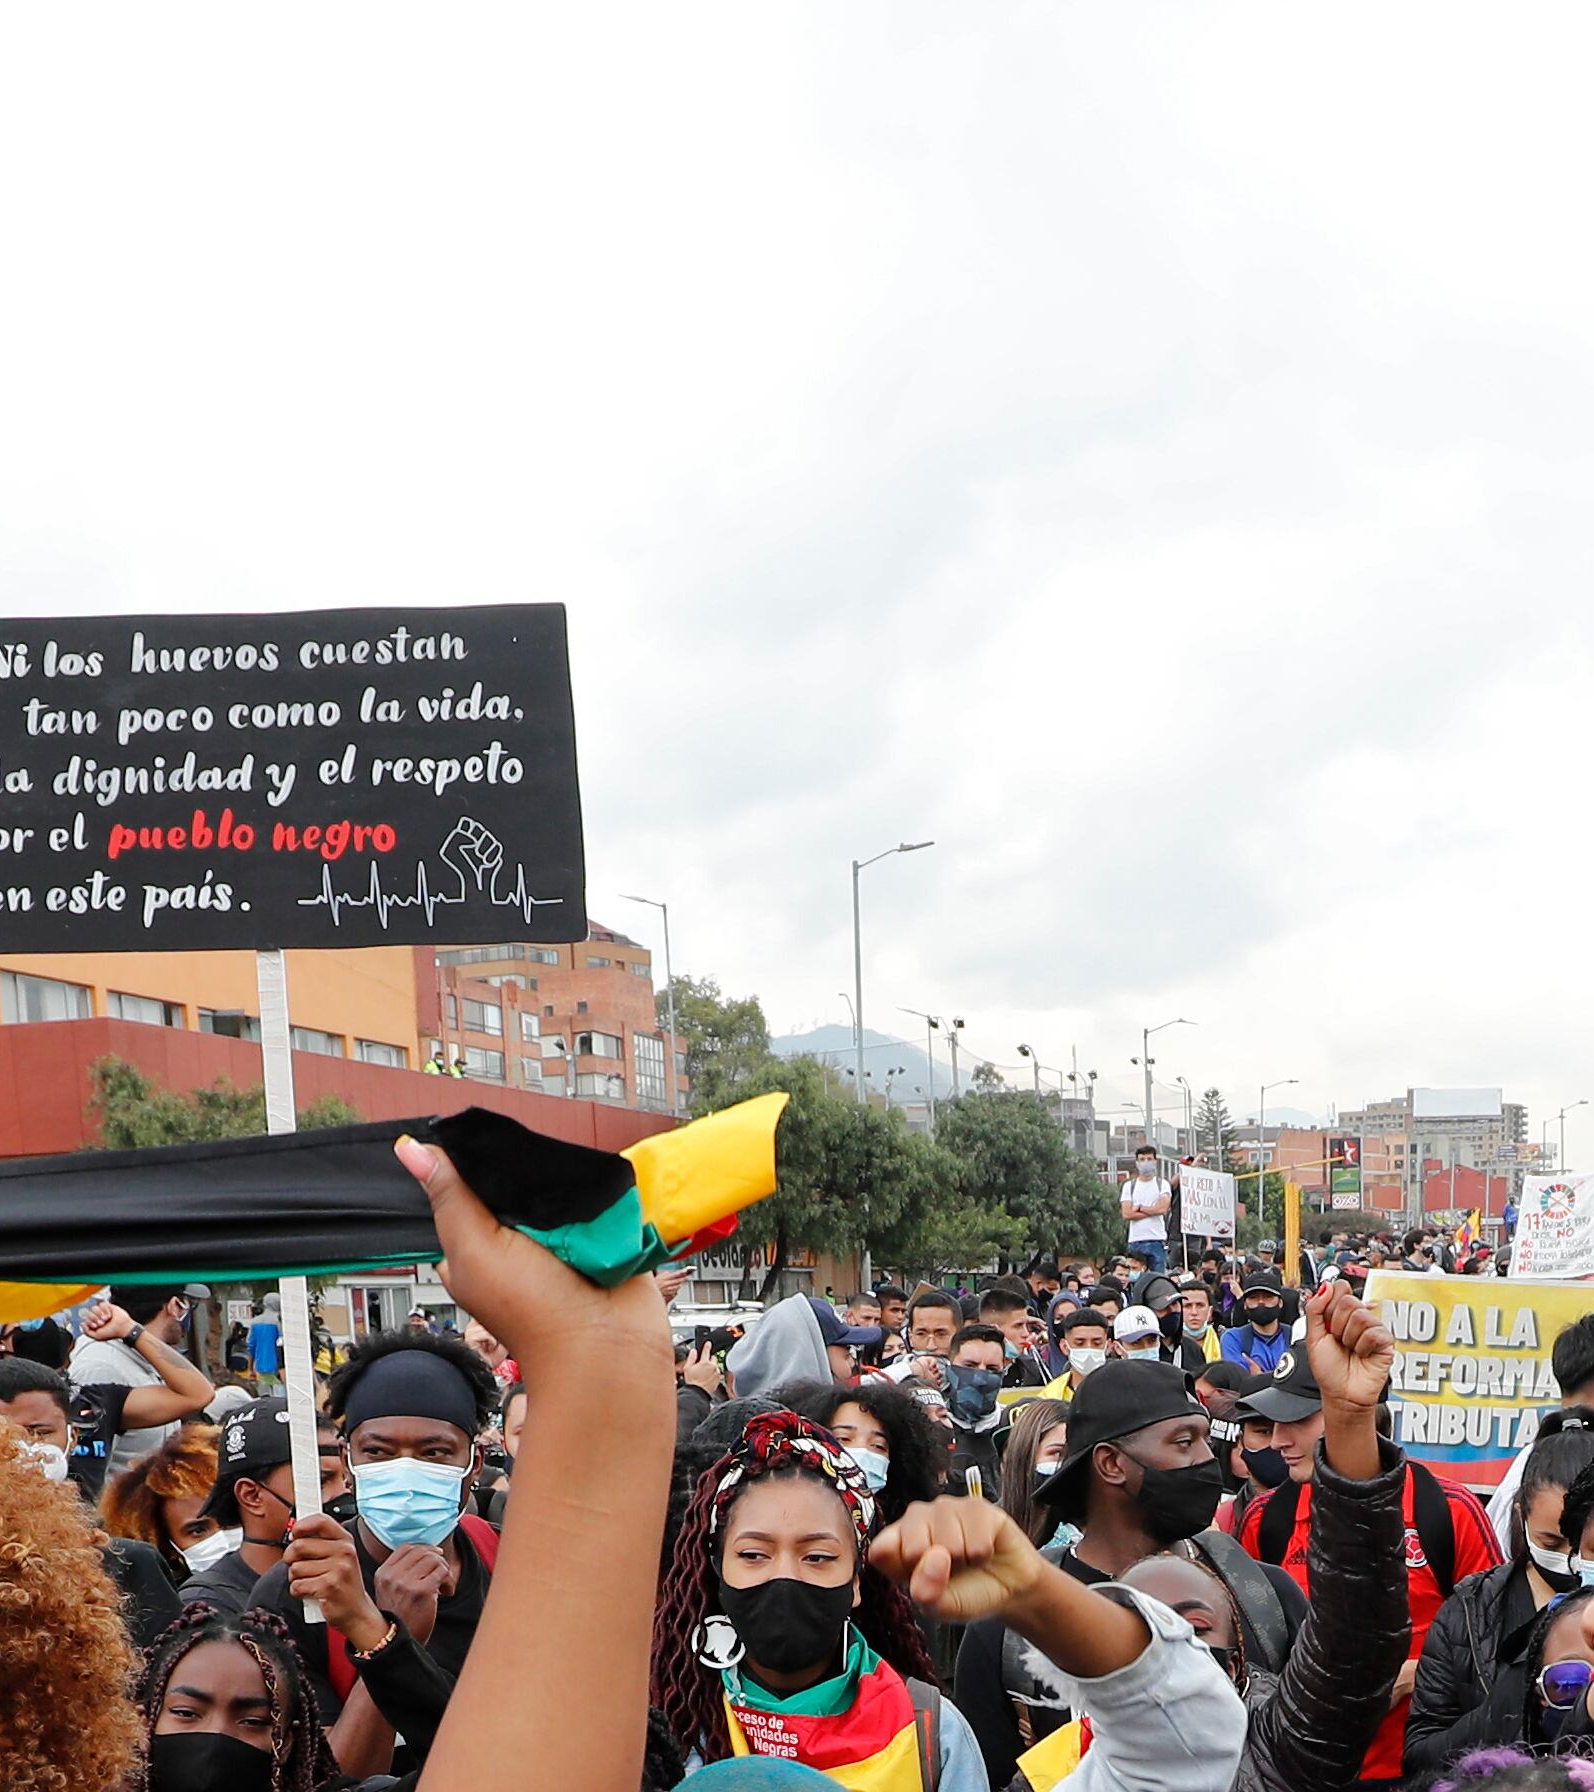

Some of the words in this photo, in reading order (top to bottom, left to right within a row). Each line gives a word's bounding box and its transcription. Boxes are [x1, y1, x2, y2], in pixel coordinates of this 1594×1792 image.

[43, 639, 104, 677] los
[132, 632, 280, 674] huevos
[299, 626, 468, 669] cuestan
[24, 697, 100, 735] tan
[118, 706, 214, 746] poco
[228, 700, 341, 729] como
[359, 686, 405, 725] la
[52, 751, 254, 806] dignidad
[264, 762, 297, 806] y
[318, 743, 356, 786] el
[370, 740, 524, 796] respeto
[48, 812, 88, 852] el
[107, 808, 254, 860] pueblo
[272, 821, 397, 861] negro
[45, 871, 126, 913] este
[142, 869, 251, 928] país.
[1382, 1300, 1437, 1342] NO
[1445, 1304, 1476, 1347] A
[1486, 1307, 1538, 1348] LA
[1389, 1353, 1562, 1400] REFORMA
[1388, 1400, 1548, 1448] TRIBUTA
[768, 1715, 784, 1730] de
[754, 1737, 798, 1758] Negras
